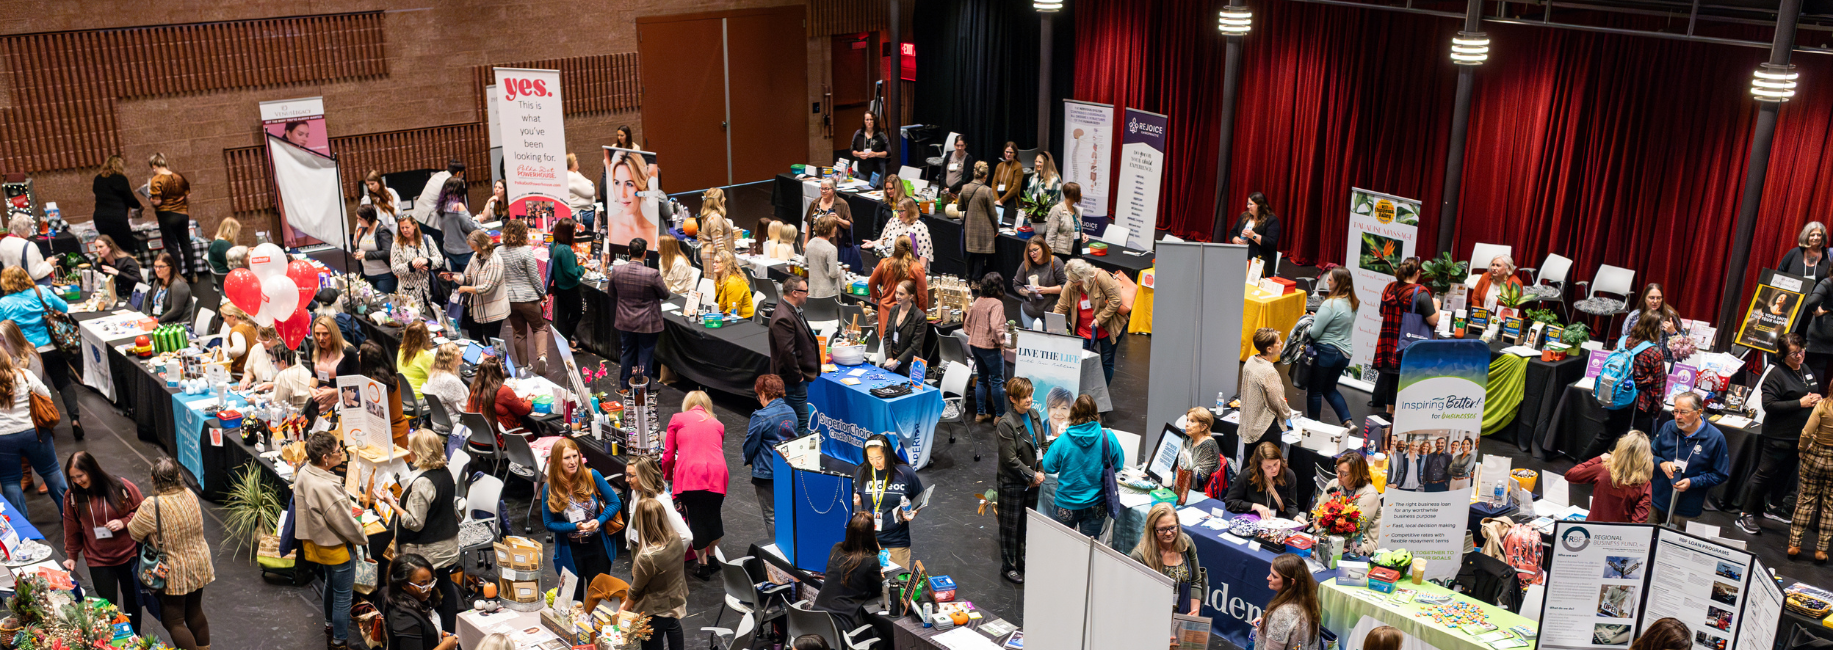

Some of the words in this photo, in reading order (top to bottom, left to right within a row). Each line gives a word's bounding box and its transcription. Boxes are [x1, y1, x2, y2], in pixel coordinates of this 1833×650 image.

[504, 78, 553, 102] yes.
[518, 100, 534, 110] This
[536, 101, 542, 110] is
[522, 114, 541, 122] what
[520, 127, 545, 136] you've
[1139, 122, 1162, 134] REJOICE
[524, 140, 544, 148] been
[514, 152, 542, 162] looking
[543, 152, 556, 162] for.
[1082, 220, 1098, 229] JOICE
[1019, 347, 1038, 358] LIVE
[1040, 350, 1058, 361] THE
[1060, 353, 1080, 364] LIFE
[1402, 400, 1444, 410] Inspiring
[1446, 394, 1481, 409] Better!
[1702, 544, 1730, 556] PROGRAMS
[1205, 582, 1266, 626] den
[1604, 602, 1618, 615] OPEN
